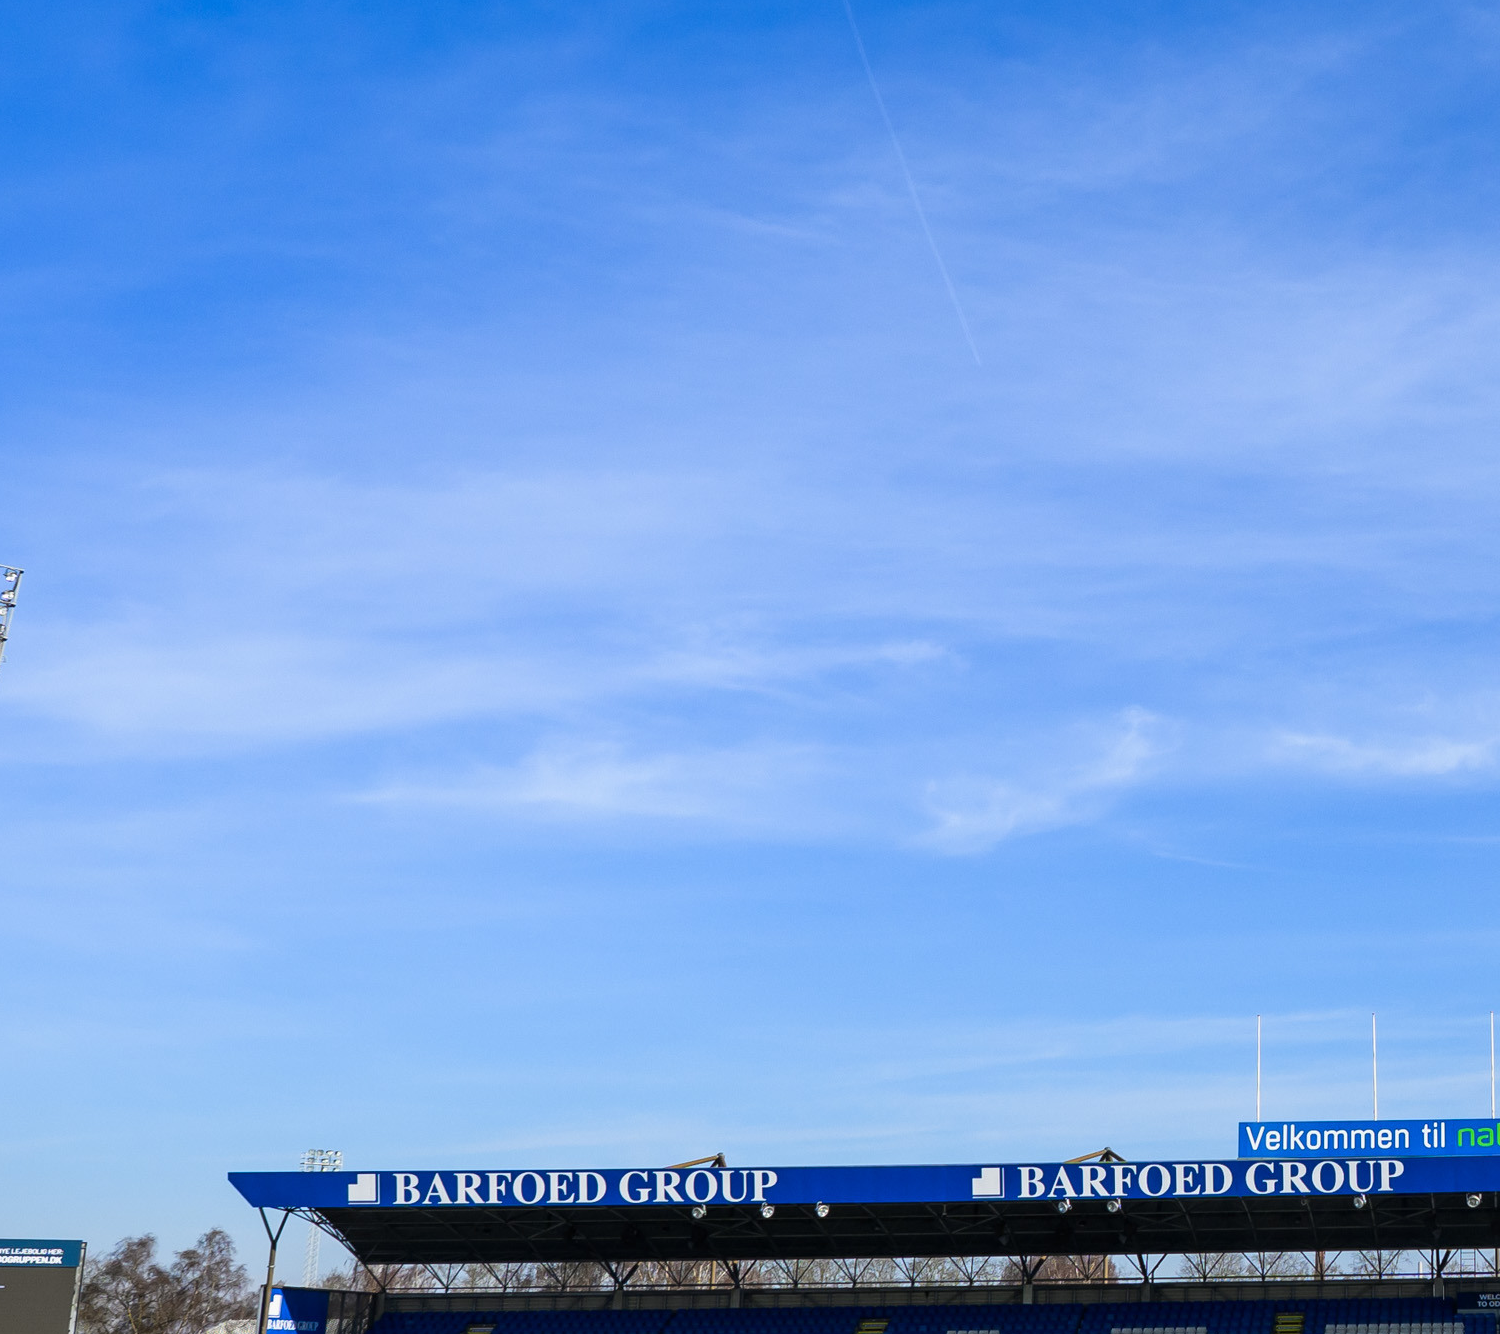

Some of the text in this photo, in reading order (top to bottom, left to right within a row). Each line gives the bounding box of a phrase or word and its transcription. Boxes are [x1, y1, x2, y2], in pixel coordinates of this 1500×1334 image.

[1246, 1124, 1409, 1150] Velkommen
[1421, 1122, 1445, 1148] til
[392, 1170, 778, 1206] BARFOED GROUP
[1017, 1160, 1405, 1199] BARFOED GROUP
